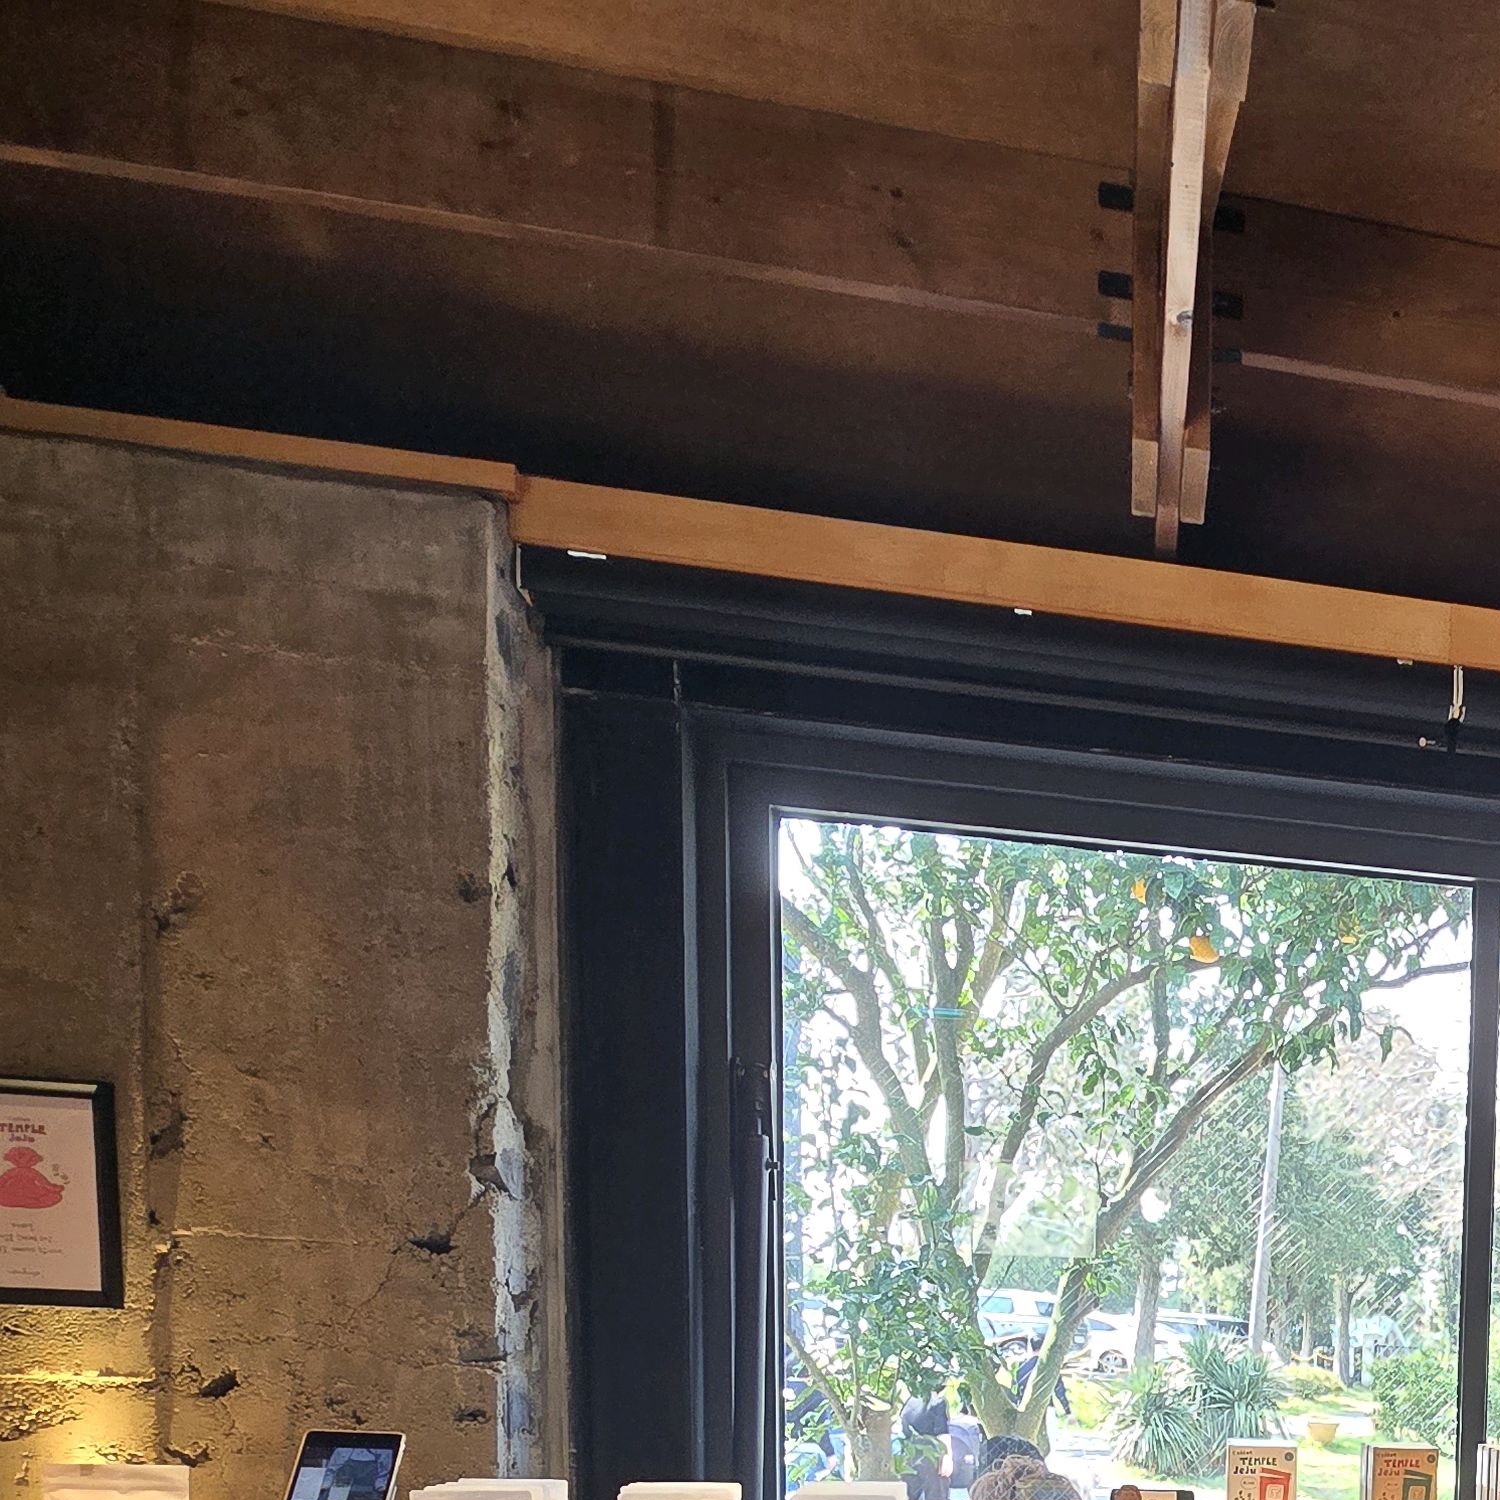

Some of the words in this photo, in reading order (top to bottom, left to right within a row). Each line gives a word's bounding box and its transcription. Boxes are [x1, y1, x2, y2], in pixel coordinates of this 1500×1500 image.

[0, 1122, 46, 1135] TEMPLE
[1240, 1457, 1277, 1466] TEMPLE
[1384, 1459, 1420, 1468] TEMPLE
